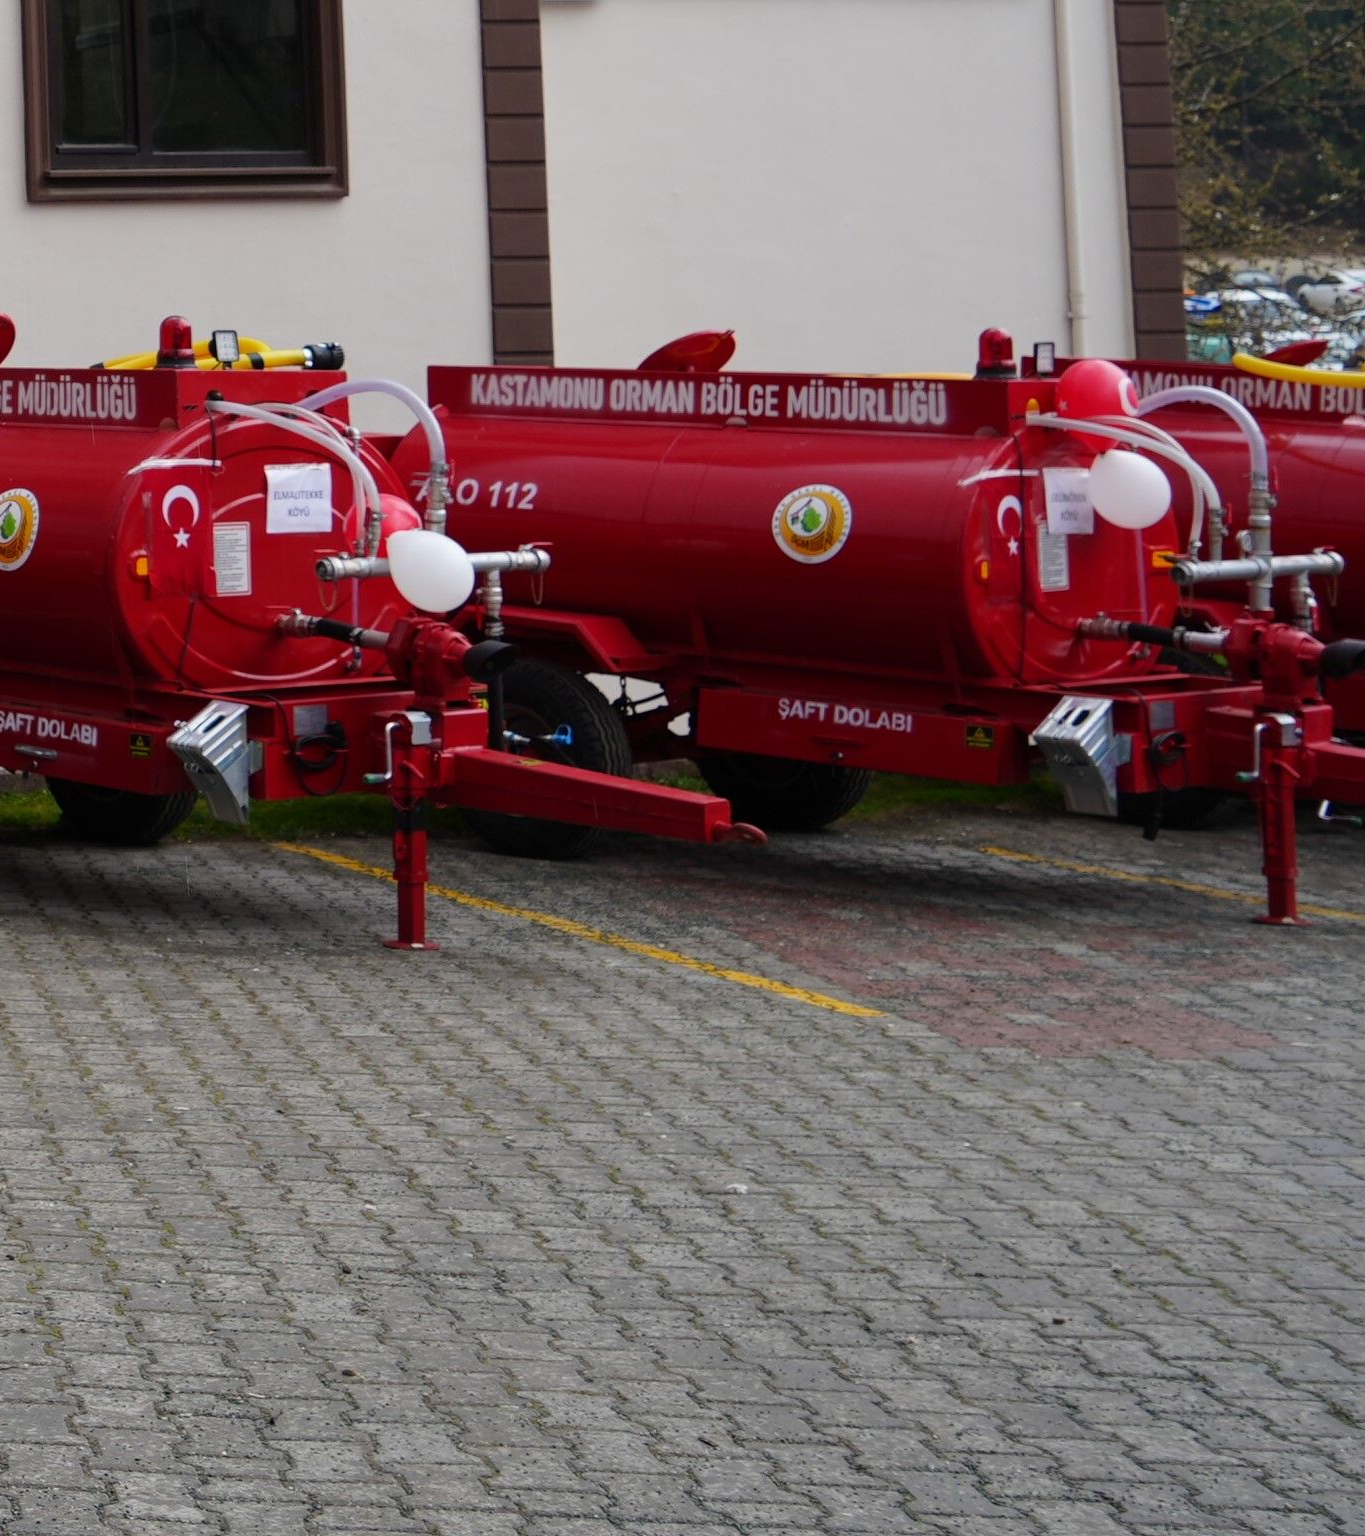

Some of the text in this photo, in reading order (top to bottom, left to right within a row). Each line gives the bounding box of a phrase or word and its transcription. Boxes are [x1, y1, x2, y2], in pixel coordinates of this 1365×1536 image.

[18, 374, 137, 421] MÜDÜRLÜĞÜ
[470, 373, 948, 426] KASTAMONU ORMAN BÖLGE MÜDÜRLÜĞÜ
[415, 477, 539, 510] AO 112
[37, 716, 98, 747] DOLABI
[777, 697, 914, 734] ŞAFT DOLABI
